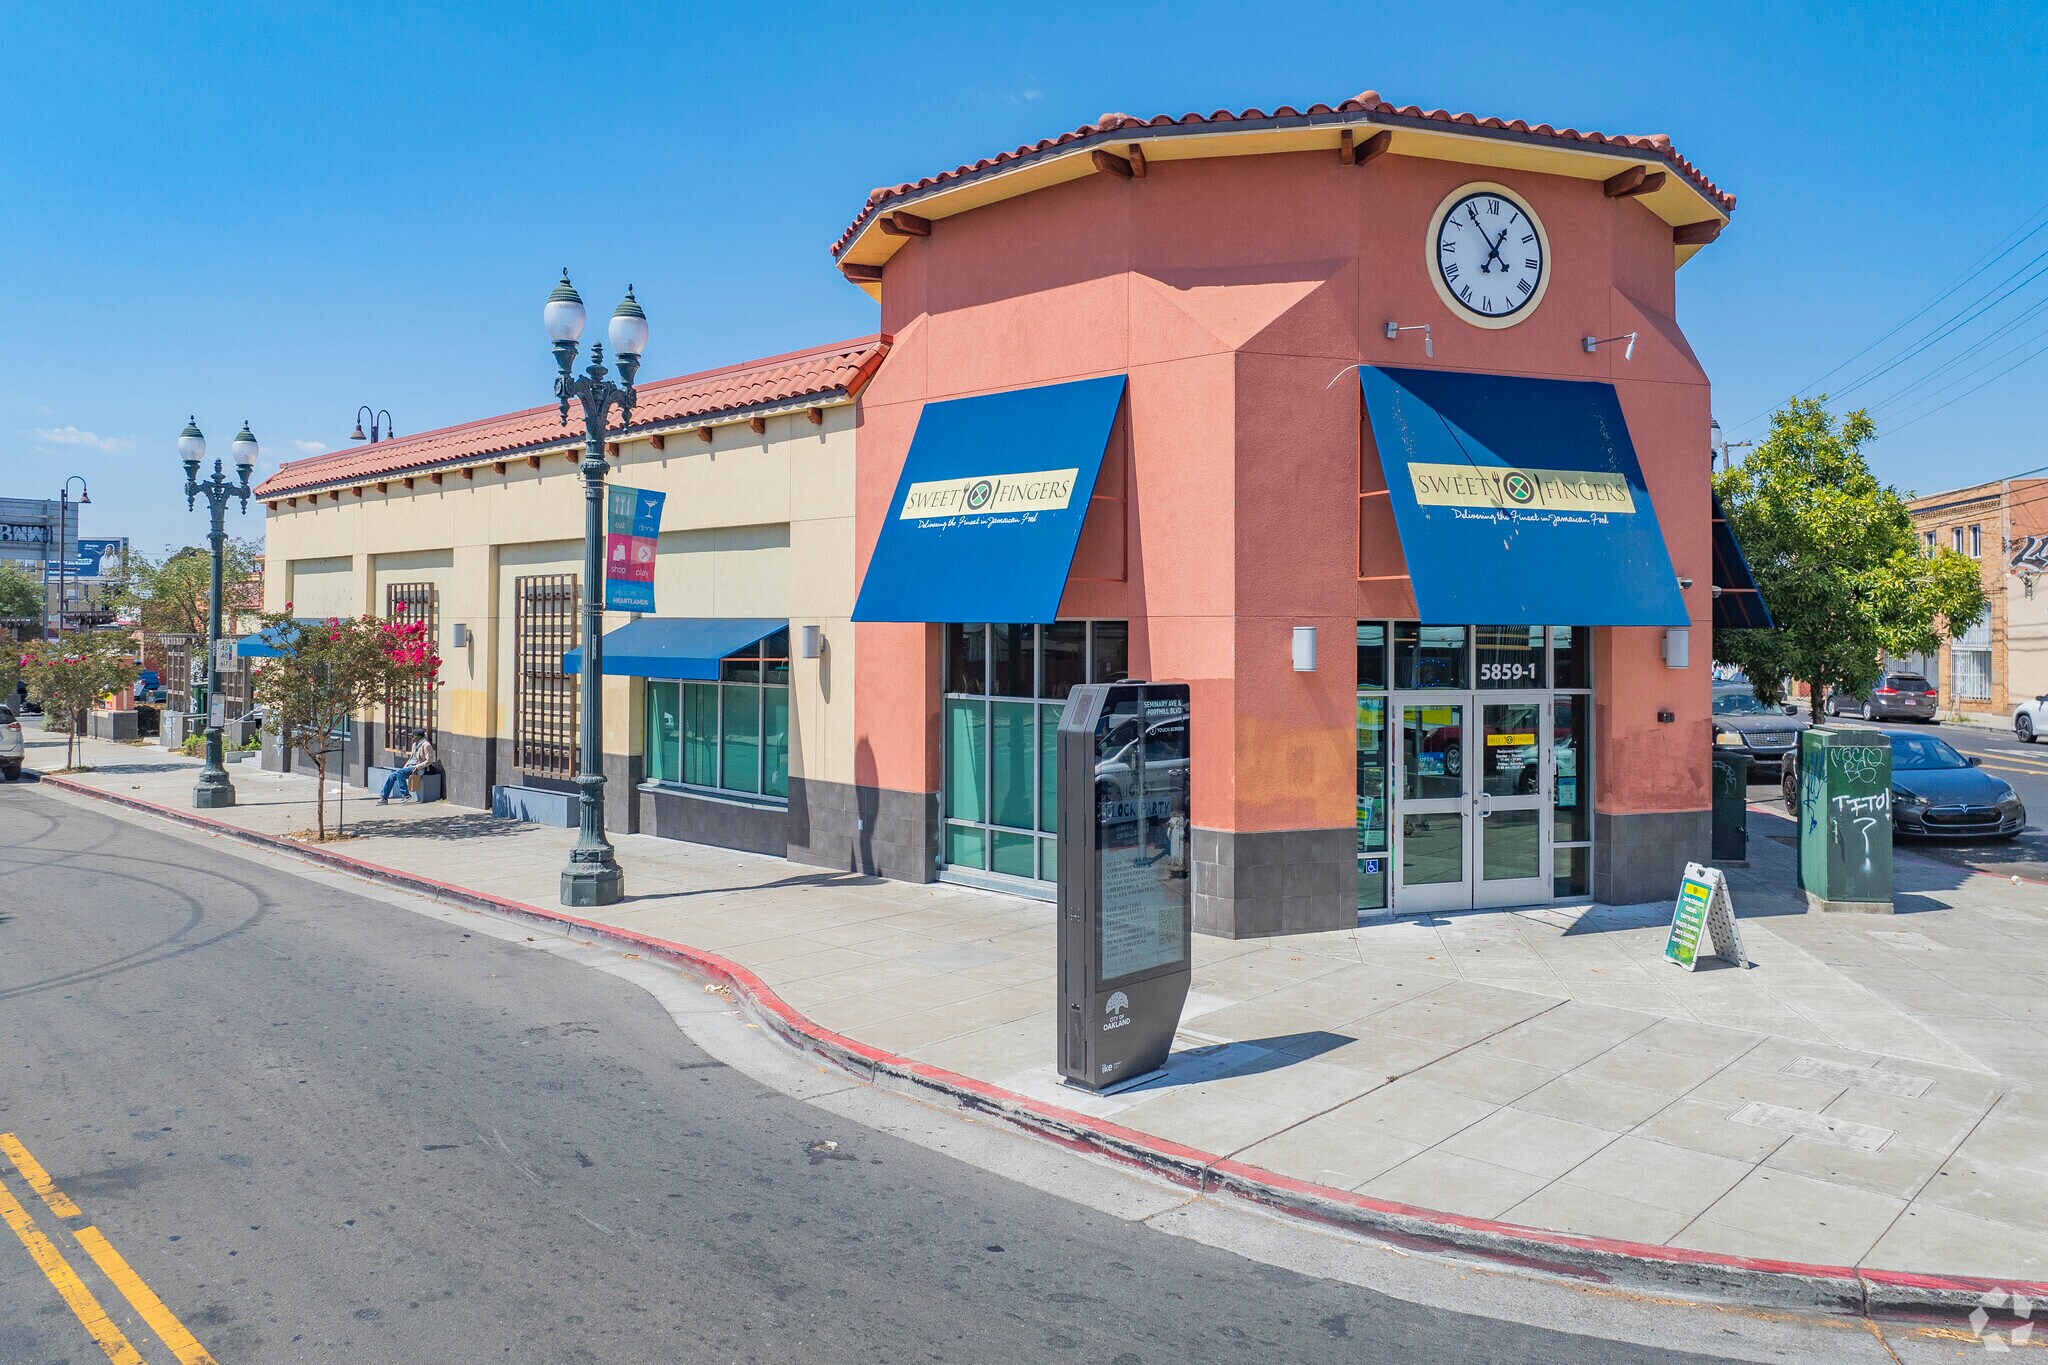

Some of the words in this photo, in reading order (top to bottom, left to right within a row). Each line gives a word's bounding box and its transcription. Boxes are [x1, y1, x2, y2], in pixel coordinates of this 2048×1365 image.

[1487, 199, 1500, 216] XII
[1450, 216, 1463, 231] X
[1510, 213, 1519, 225] I
[1521, 234, 1535, 245] II
[1525, 258, 1538, 270] III
[1445, 263, 1460, 283] VIII
[1460, 284, 1473, 304] VII
[1483, 296, 1493, 312] VI
[1506, 296, 1515, 310] V
[907, 489, 961, 510] SWEET
[1000, 480, 1070, 502] FINGERS
[1418, 475, 1489, 496] SWEET
[1545, 481, 1626, 502] FINGERS
[918, 520, 947, 531] Delivering
[948, 517, 957, 527] the
[958, 516, 980, 528] Finest
[988, 516, 1021, 528] Jamaican
[1021, 512, 1039, 525] Food
[1451, 508, 1497, 525] Delivering
[1497, 510, 1510, 521] the
[1511, 510, 1540, 523] Finest
[1541, 514, 1550, 522] in
[1550, 513, 1590, 526] Jamaican
[1590, 513, 1609, 526] Food
[611, 565, 626, 575] shop
[636, 569, 649, 578] play
[613, 598, 648, 606] HEARTLANDS
[1481, 663, 1535, 680] 5859-1
[1116, 781, 1155, 798] AUGUST
[1141, 801, 1170, 817] PARTY
[1103, 1018, 1131, 1031] OAKLAND
[1110, 1015, 1119, 1023] CITY
[1102, 1063, 1113, 1074] ike
